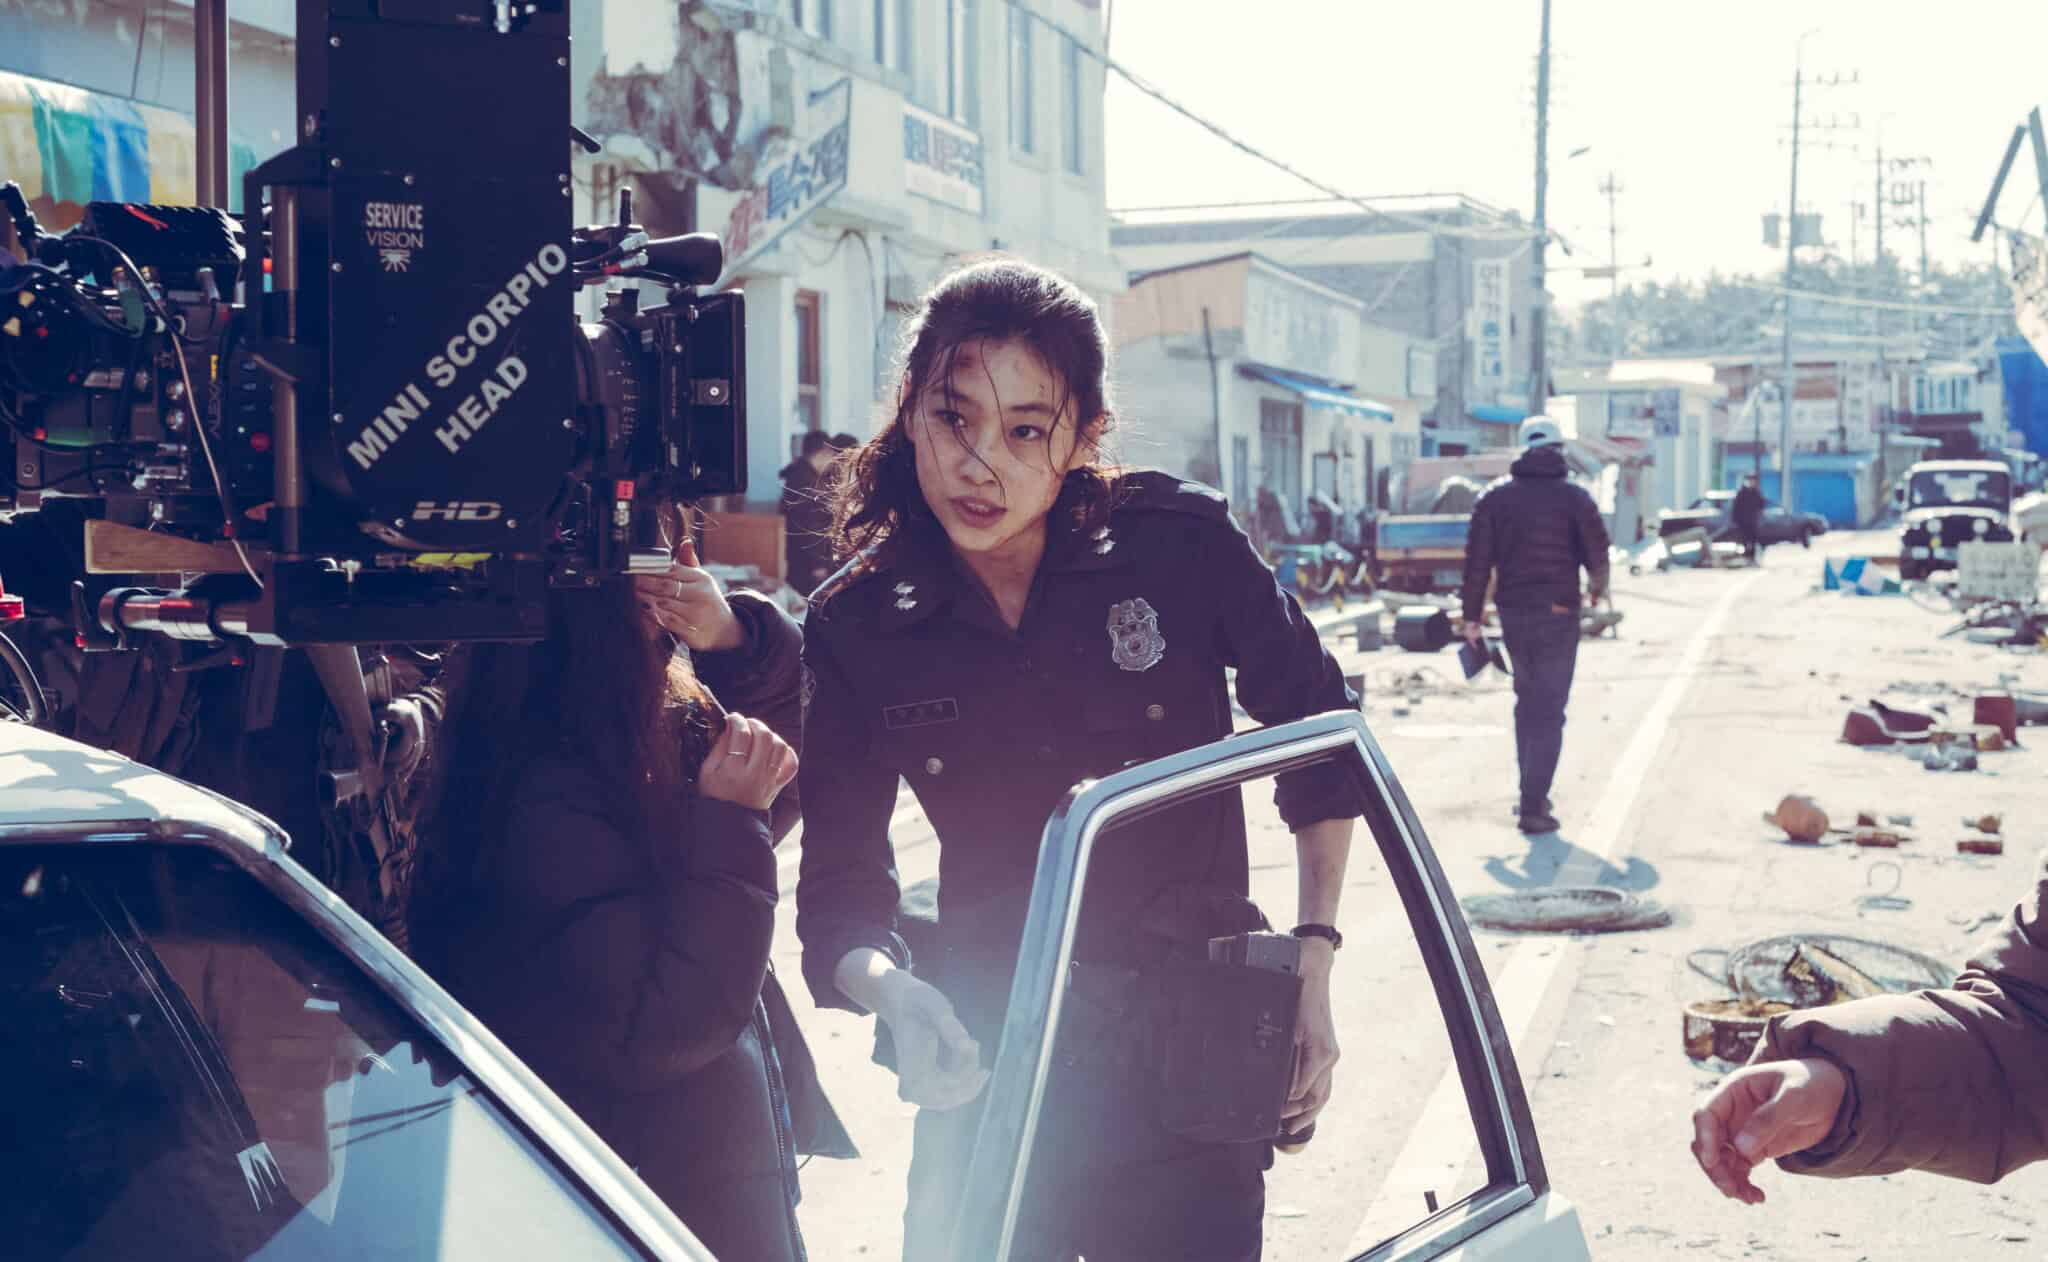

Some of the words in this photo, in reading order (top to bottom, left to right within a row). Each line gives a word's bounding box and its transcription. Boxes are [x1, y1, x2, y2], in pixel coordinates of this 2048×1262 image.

[365, 203, 424, 230] SERVICE
[366, 230, 424, 249] VISION
[347, 383, 432, 470] MINI
[425, 243, 567, 389] SCORPIO
[434, 356, 528, 454] HEAD
[412, 501, 503, 521] HD
